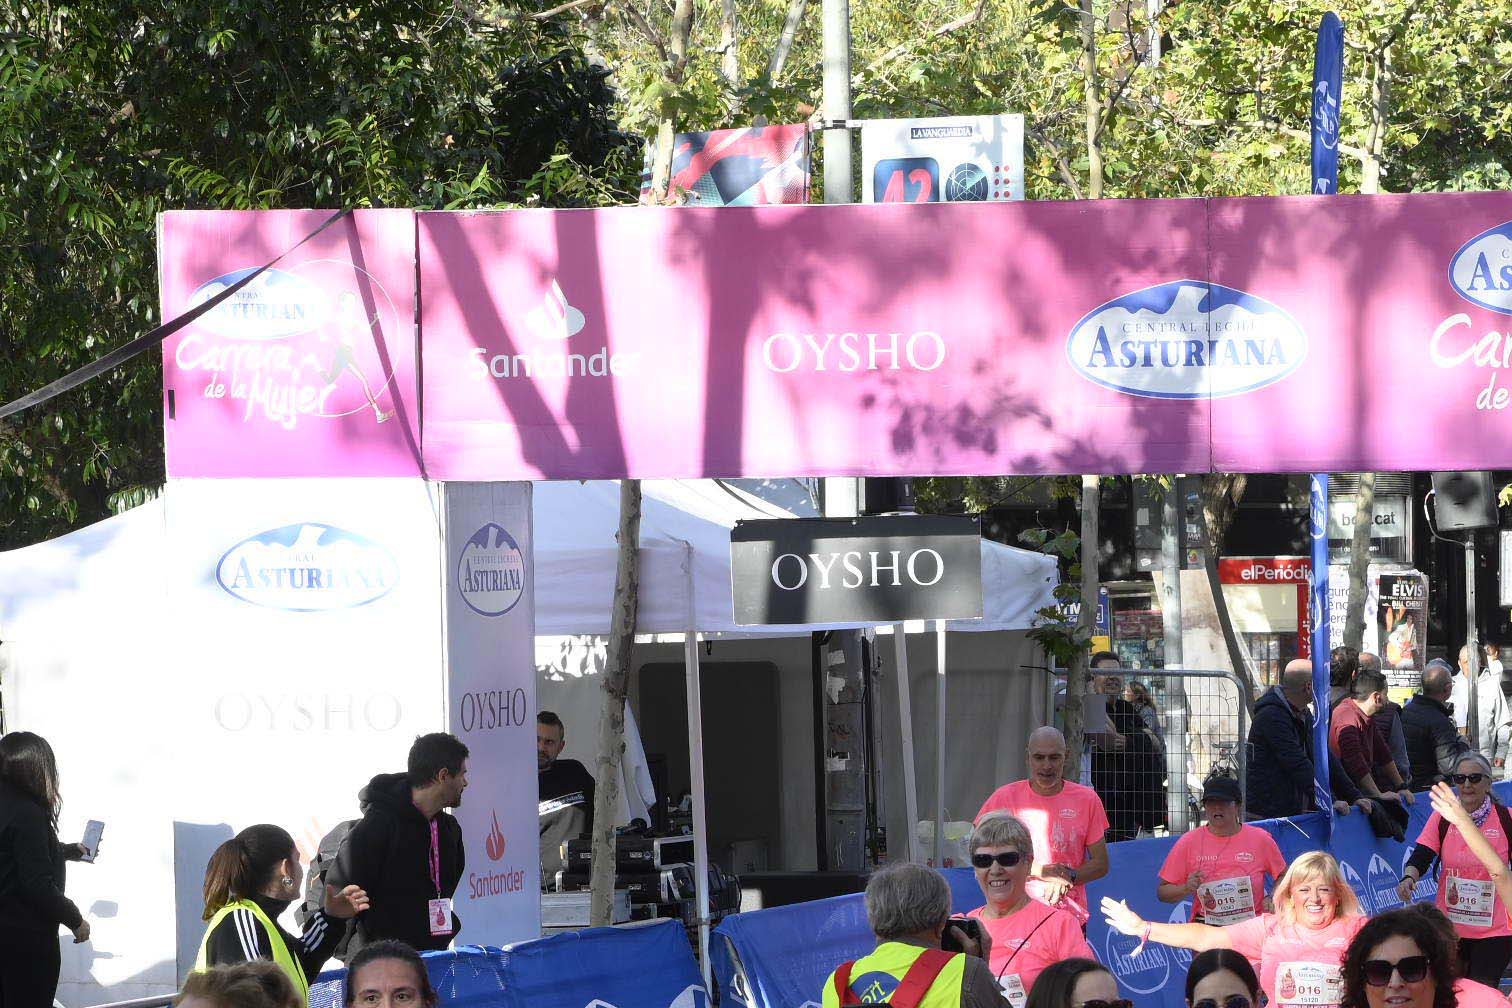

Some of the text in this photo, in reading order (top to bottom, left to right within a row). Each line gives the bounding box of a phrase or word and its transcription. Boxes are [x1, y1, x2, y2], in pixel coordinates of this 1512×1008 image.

[1120, 321, 1197, 335] CENTRAL
[174, 333, 295, 371] Carrera
[467, 345, 641, 381] Santander
[763, 331, 946, 374] OYSHO
[1085, 331, 1289, 371] ASTURIANA
[203, 371, 337, 427] de la Mujer
[1476, 374, 1509, 411] de
[463, 558, 522, 592] ASTURIANA
[771, 548, 945, 591] OYSHO
[1391, 584, 1423, 597] ELVIS
[214, 691, 402, 733] OYSHO
[460, 687, 527, 732] OYSHO
[469, 868, 525, 900] Santander
[1217, 896, 1236, 905] 016
[1459, 896, 1477, 904] 016
[1298, 985, 1321, 995] 016
